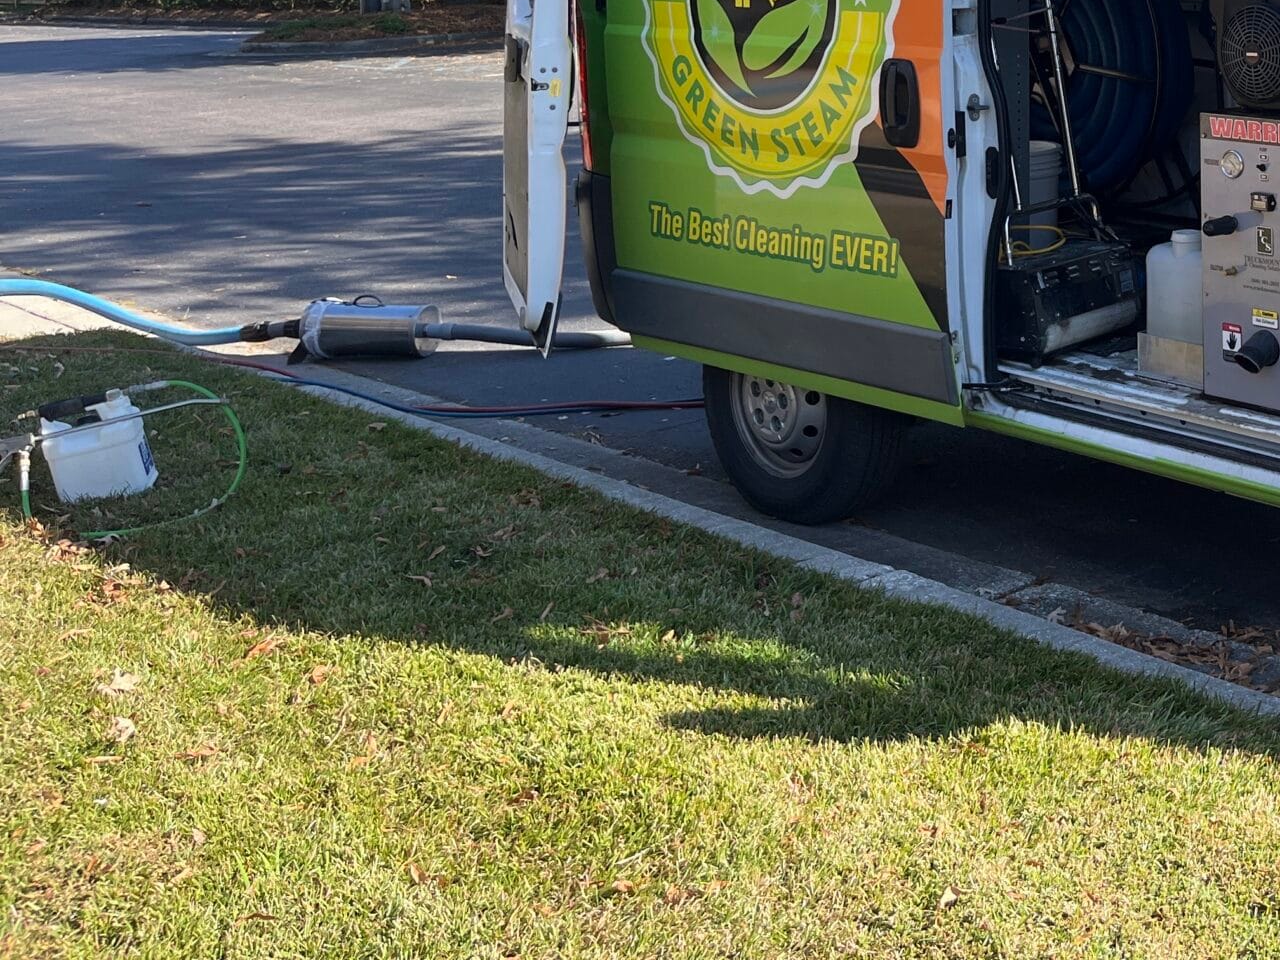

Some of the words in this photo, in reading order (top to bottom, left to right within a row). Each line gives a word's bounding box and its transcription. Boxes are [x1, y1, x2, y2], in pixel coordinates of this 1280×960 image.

[671, 54, 760, 161] GREEN
[770, 65, 858, 163] STEAM
[650, 204, 682, 238] The
[688, 210, 729, 247] Best
[735, 218, 825, 269] Cleaning
[831, 233, 898, 274] EVER!
